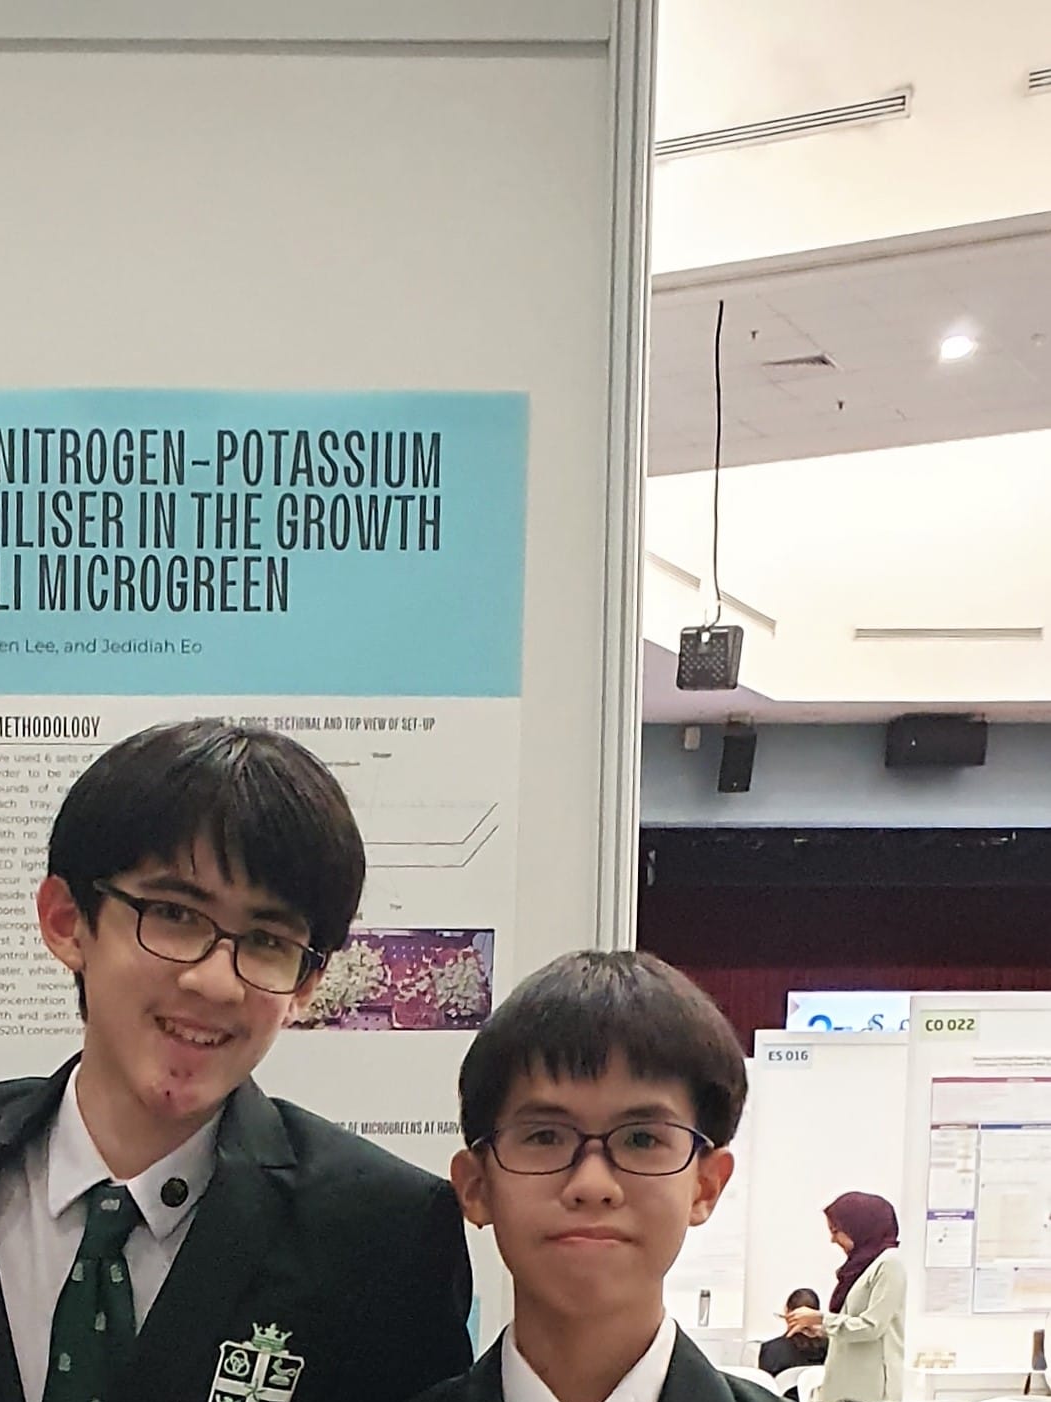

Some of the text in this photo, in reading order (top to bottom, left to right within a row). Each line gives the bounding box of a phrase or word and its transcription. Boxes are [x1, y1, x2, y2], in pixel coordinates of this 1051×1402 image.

[140, 492, 175, 549] IN
[192, 493, 261, 550] THE
[277, 493, 440, 551] GROWTH
[39, 555, 288, 611] MICROGREEN
[26, 639, 58, 656] Lee,
[64, 639, 96, 654] and
[103, 639, 175, 654] Jedidiah
[181, 639, 202, 654] Eo
[926, 1019, 974, 1031] CO 022
[769, 1051, 808, 1061] ES 016
